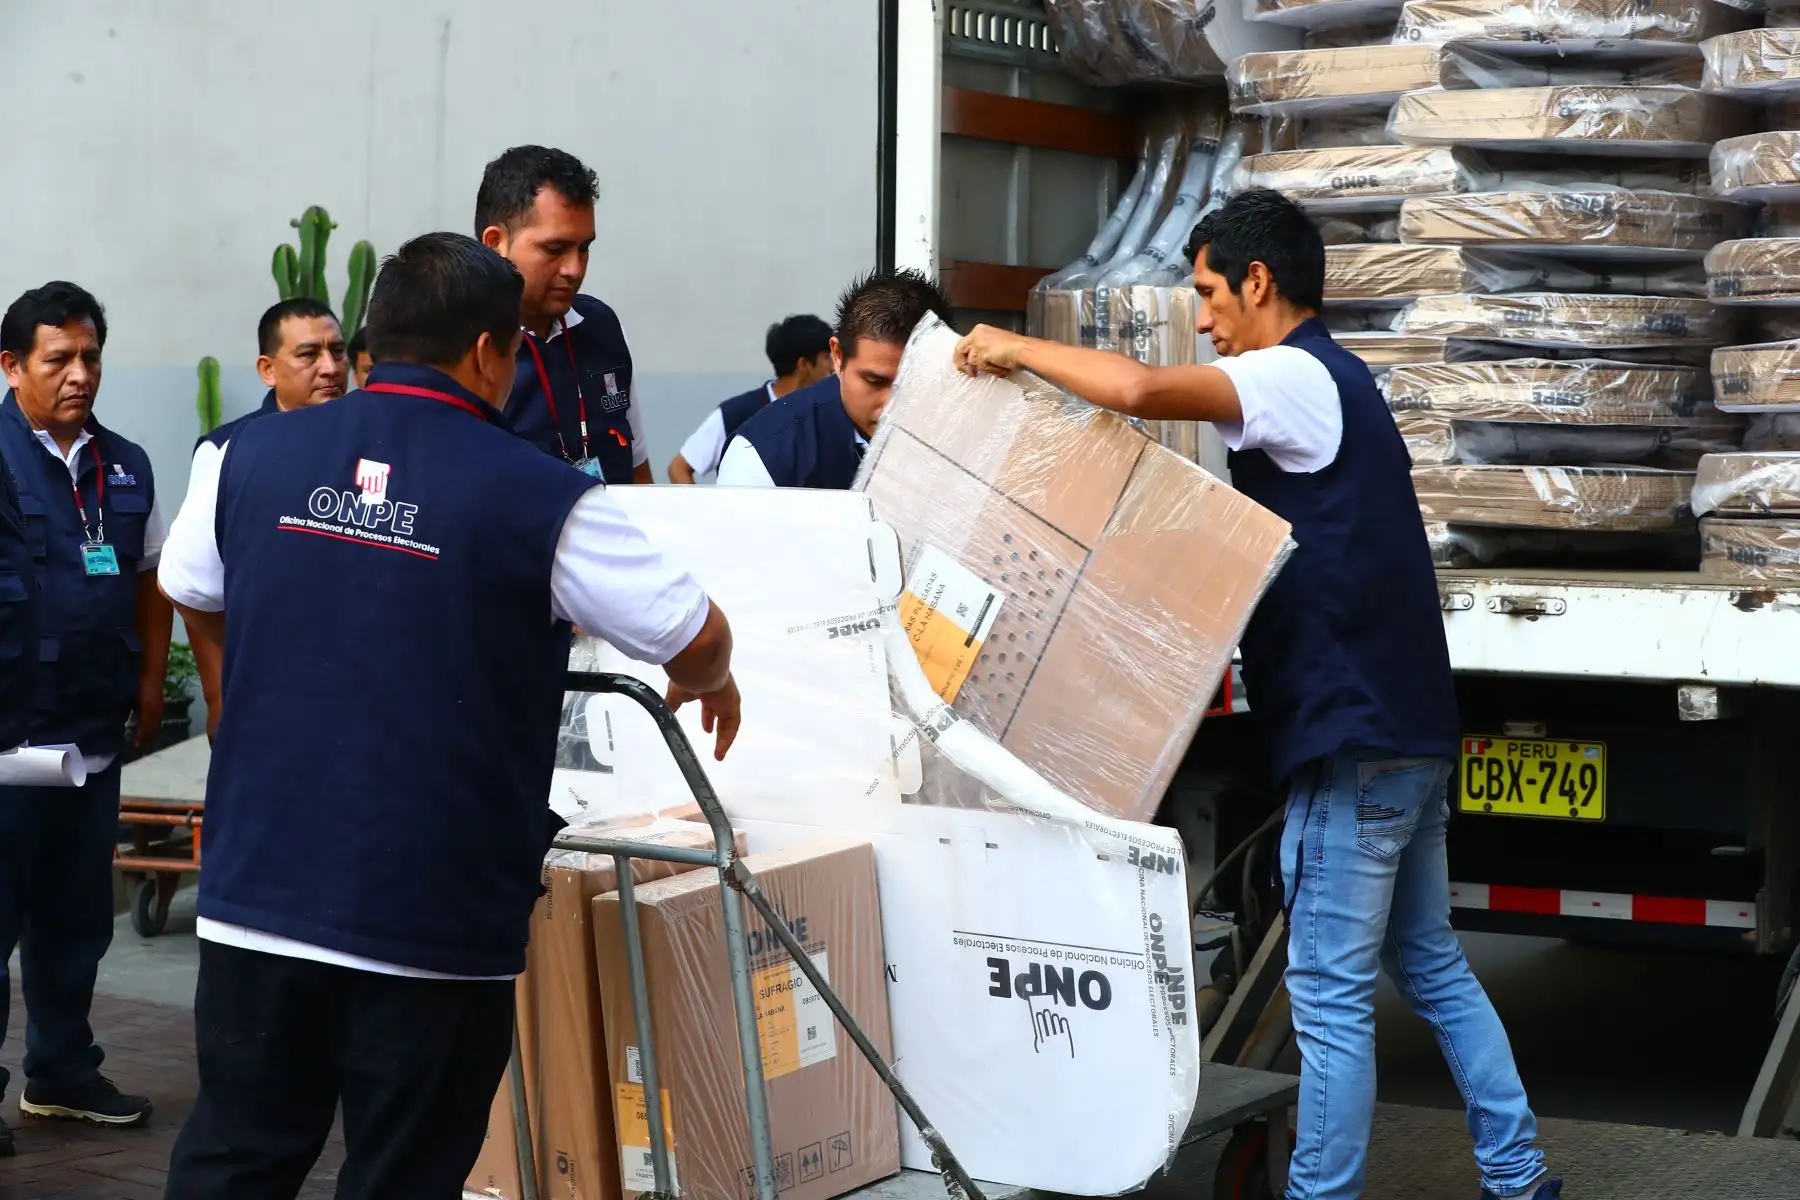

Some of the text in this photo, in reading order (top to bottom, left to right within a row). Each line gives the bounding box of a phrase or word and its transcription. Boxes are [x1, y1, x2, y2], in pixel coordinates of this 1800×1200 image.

[1331, 174, 1379, 189] ONPE
[308, 486, 418, 535] ONPE
[279, 515, 440, 554] Oficina Nacional de Procesos Electorales
[1507, 742, 1557, 759] PERU
[1466, 756, 1598, 807] CBX-749
[1085, 820, 1128, 841] ELECTORALES
[1129, 836, 1166, 852] PROCESOS
[1166, 845, 1176, 854] DE
[1140, 889, 1149, 929] NACIONAL
[953, 937, 1145, 970] Oficina Nacional de Procesos Electorales
[1145, 943, 1154, 985] PROCESOS
[1149, 912, 1169, 985] ONPE
[759, 976, 803, 1000] SUFRAGIO
[986, 956, 1113, 1011] ONPE
[1148, 986, 1159, 1037] ELECTORALES
